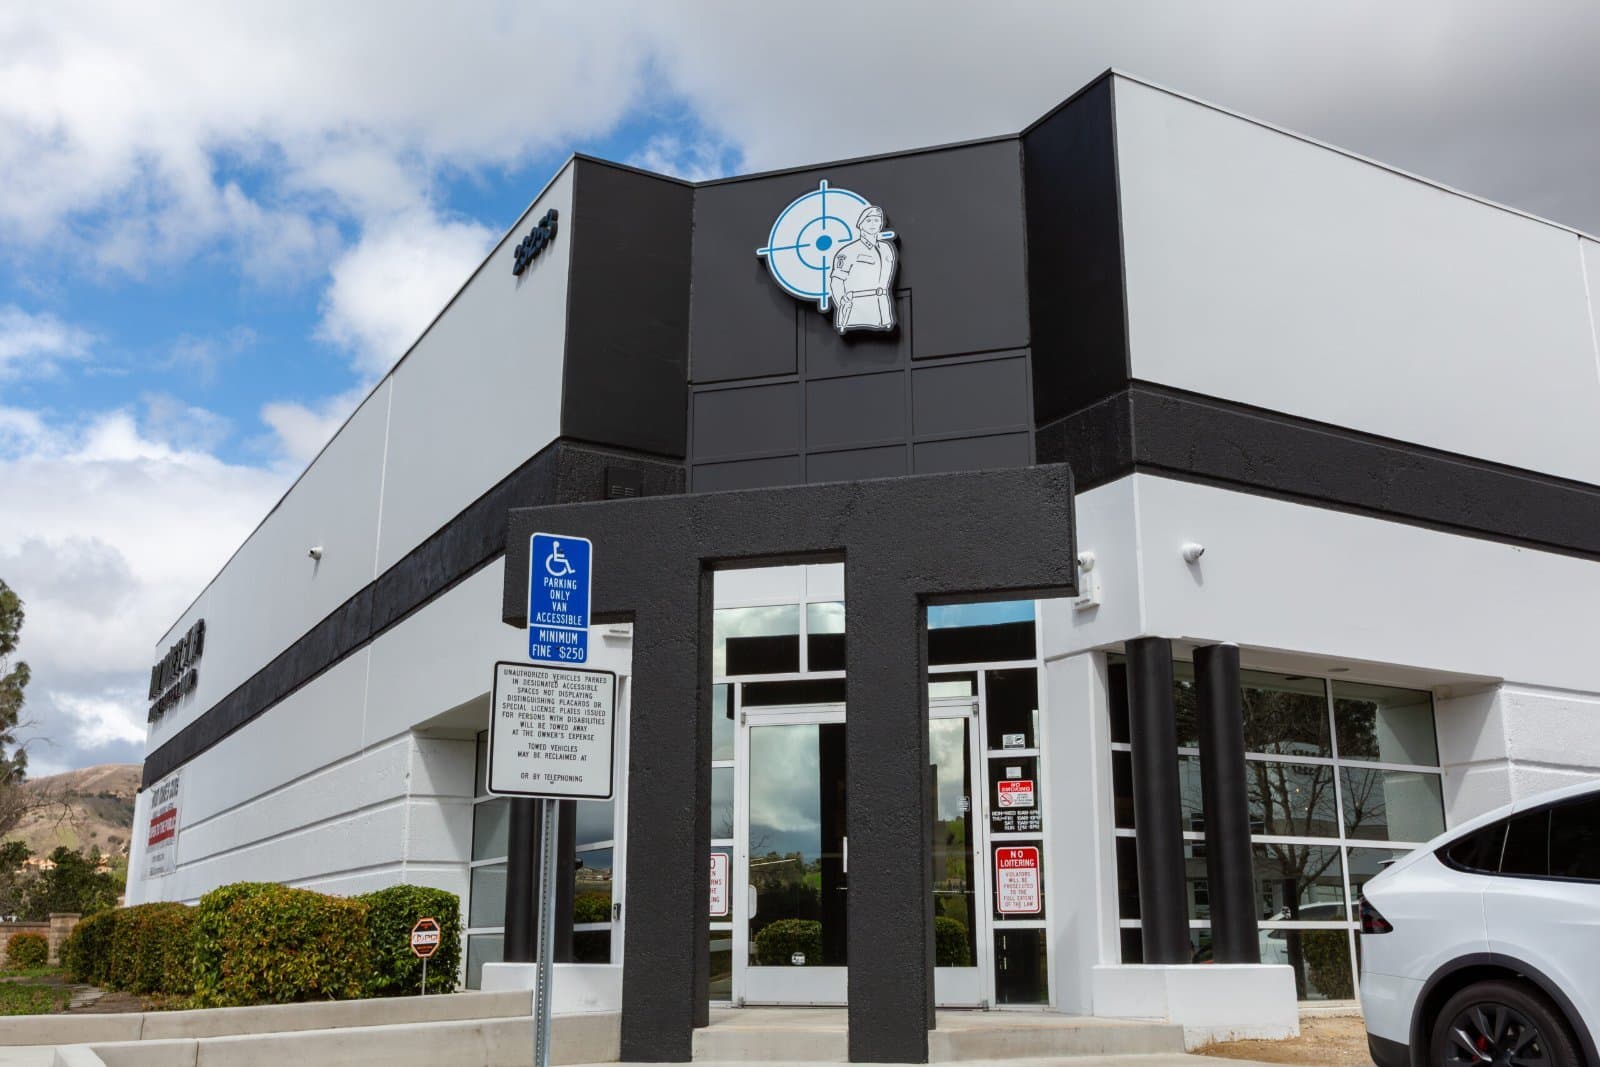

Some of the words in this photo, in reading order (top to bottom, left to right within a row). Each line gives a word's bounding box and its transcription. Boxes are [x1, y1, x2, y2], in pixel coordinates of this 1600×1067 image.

[544, 577, 576, 590] PARKING
[550, 590, 570, 600] ONLY
[552, 602, 566, 612] VAN
[536, 612, 582, 625] ACCESSIBLE
[540, 630, 578, 644] MINIMUM
[532, 645, 552, 657] FINE
[560, 647, 584, 660] $250
[504, 669, 548, 679] UNAUTHORIZED
[553, 673, 580, 682] VEHICLES
[523, 679, 558, 688] DESIGNATED
[563, 682, 598, 691] ACCESSIBLE
[558, 690, 592, 700] DISPLAYING
[508, 694, 554, 704] DISTINGUISHING
[560, 699, 590, 707] PLACARDS
[502, 702, 526, 710] SPECIAL
[568, 716, 604, 724] DISABILITIES
[538, 731, 564, 739] OWNER'S
[528, 742, 546, 750] TOWED
[550, 744, 578, 752] VEHICLES
[545, 752, 576, 760] RECLAIMED
[544, 774, 582, 782] TELEPHONING
[1000, 859, 1034, 868] LOITERING
